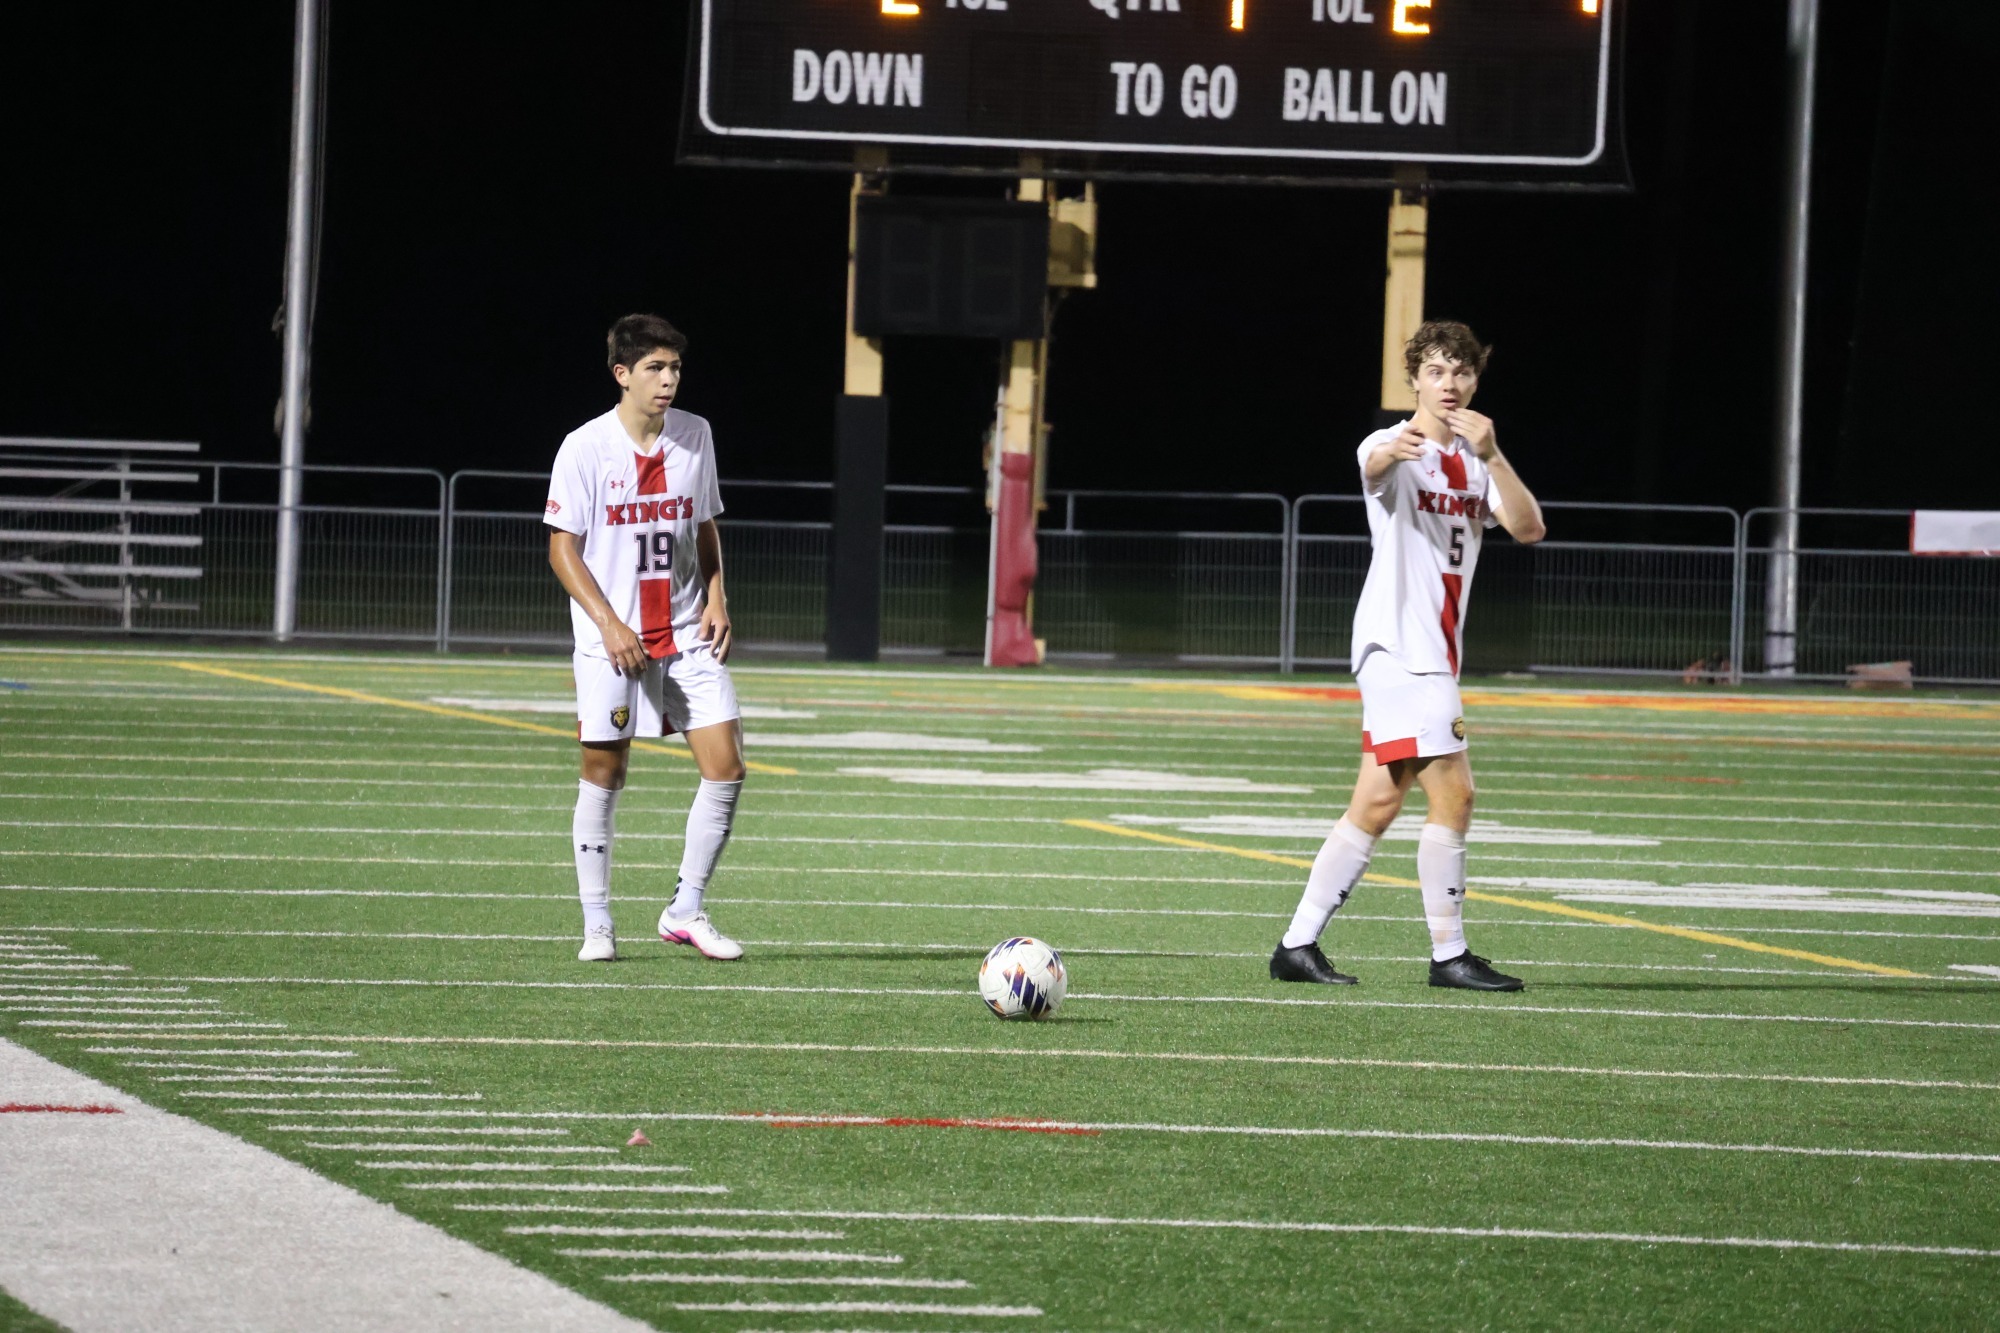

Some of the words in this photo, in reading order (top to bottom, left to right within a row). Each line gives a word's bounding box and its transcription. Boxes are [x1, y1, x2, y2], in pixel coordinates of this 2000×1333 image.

[792, 49, 923, 107] DOWN
[1110, 62, 1164, 116] TO
[1180, 64, 1238, 119] GO
[1282, 67, 1384, 124] BALL
[1390, 71, 1447, 126] ON
[606, 495, 694, 526] KING'S
[634, 529, 675, 574] 19
[1448, 525, 1465, 568] 5
